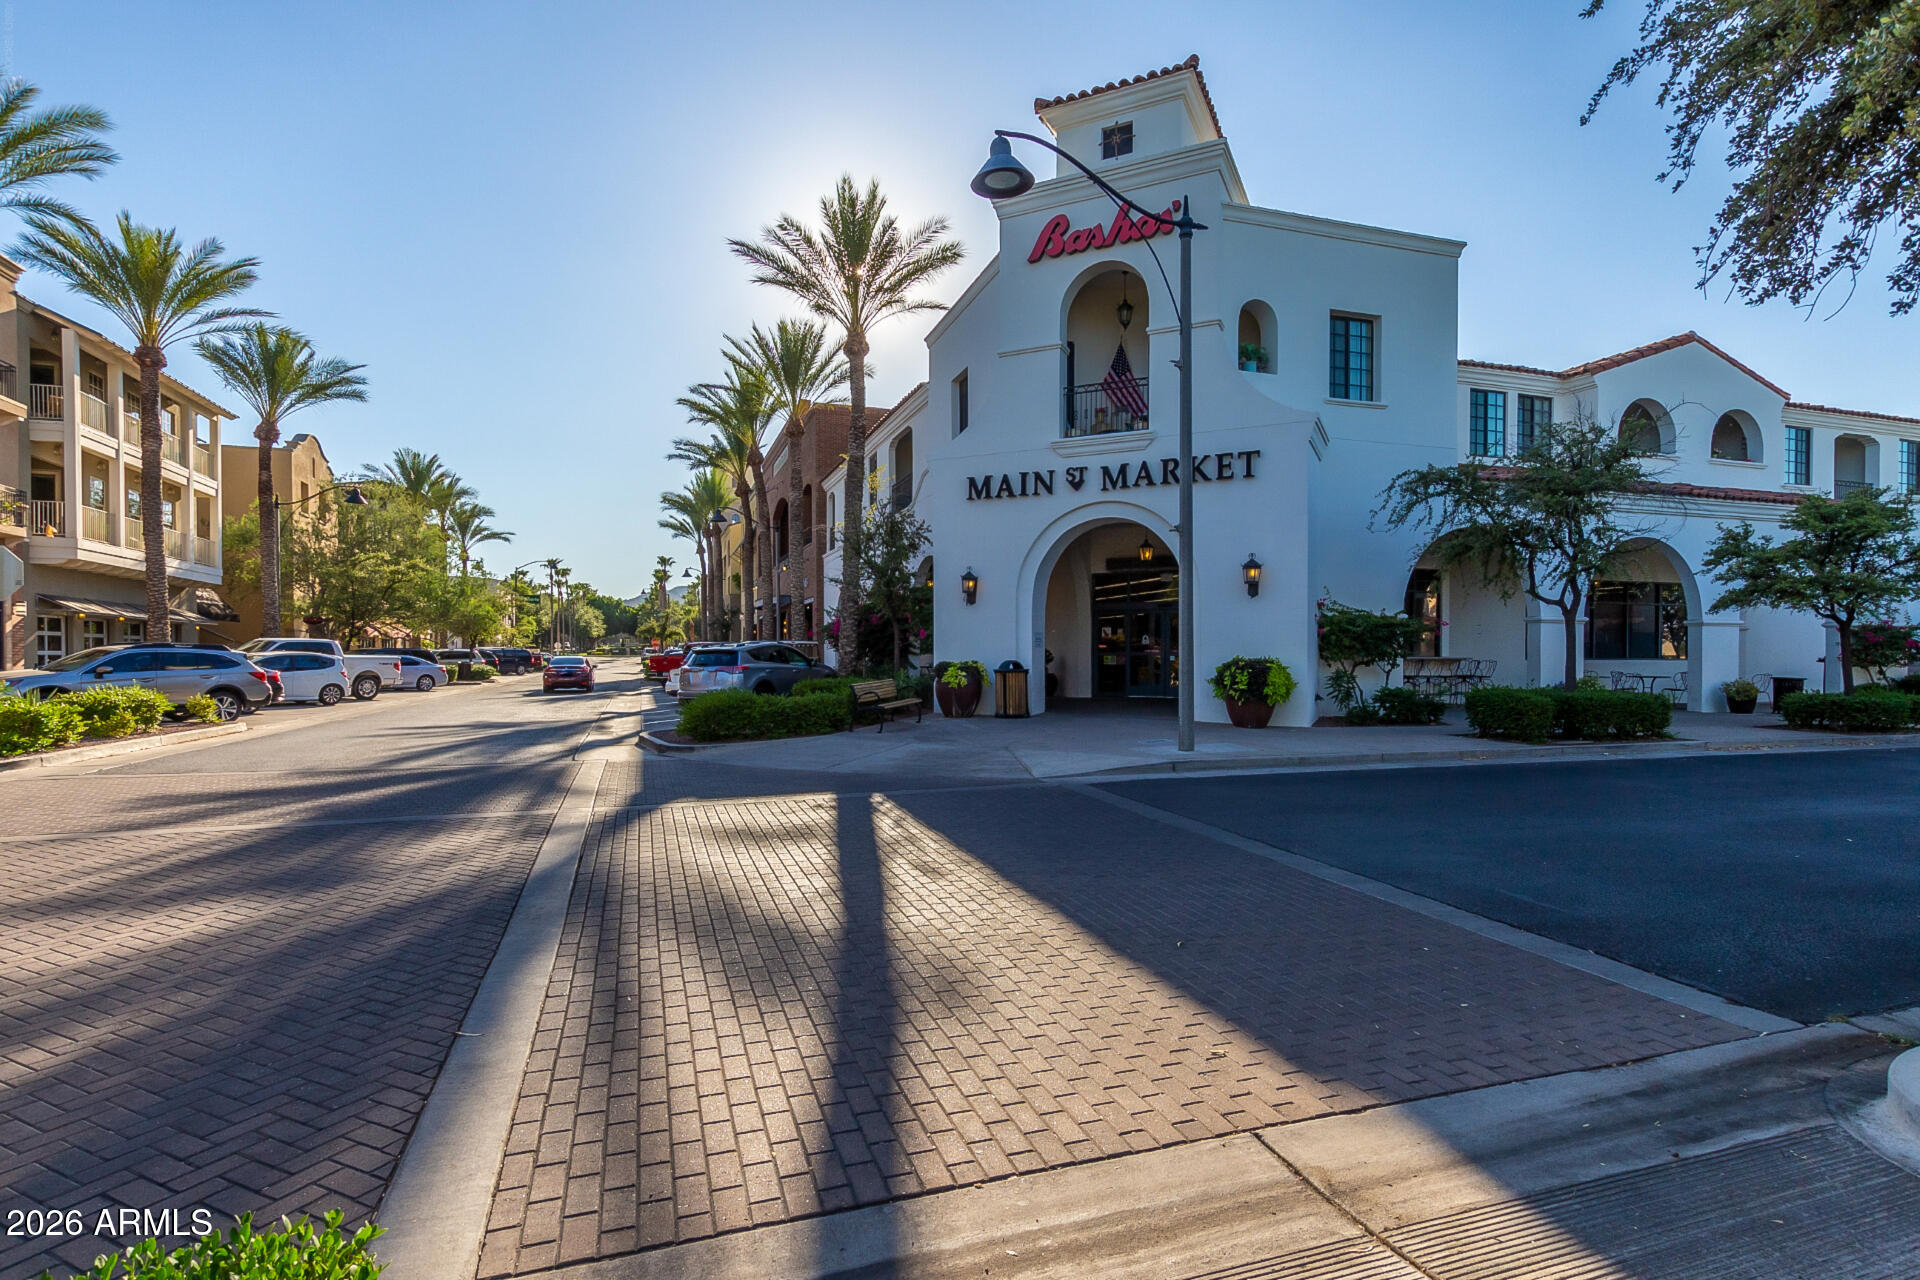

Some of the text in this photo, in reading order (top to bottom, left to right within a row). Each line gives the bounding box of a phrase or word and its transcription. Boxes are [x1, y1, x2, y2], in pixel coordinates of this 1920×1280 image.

[1027, 200, 1181, 264] Bashas'
[966, 449, 1261, 501] MAIN ST MARKET
